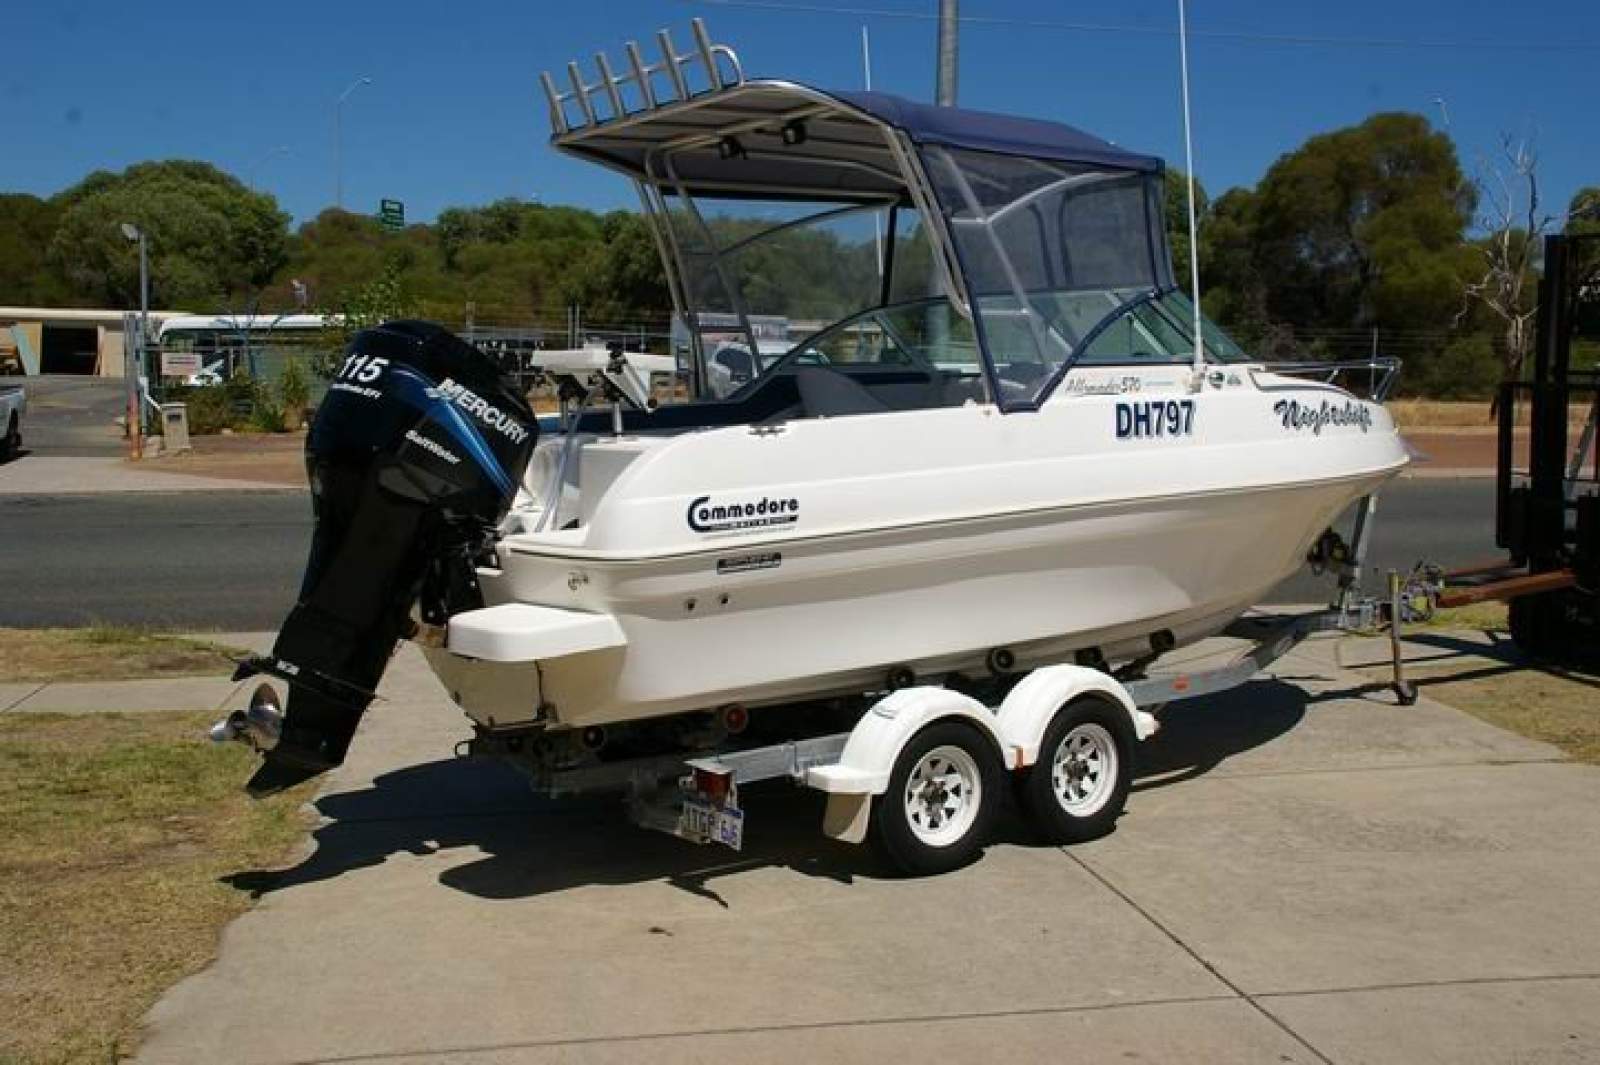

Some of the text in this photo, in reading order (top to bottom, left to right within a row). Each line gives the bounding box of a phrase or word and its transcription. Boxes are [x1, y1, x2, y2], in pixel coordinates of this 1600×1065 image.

[338, 354, 389, 382] 115
[436, 377, 529, 445] MERCURY
[1115, 400, 1195, 438] DH797
[687, 495, 799, 532] Commodore
